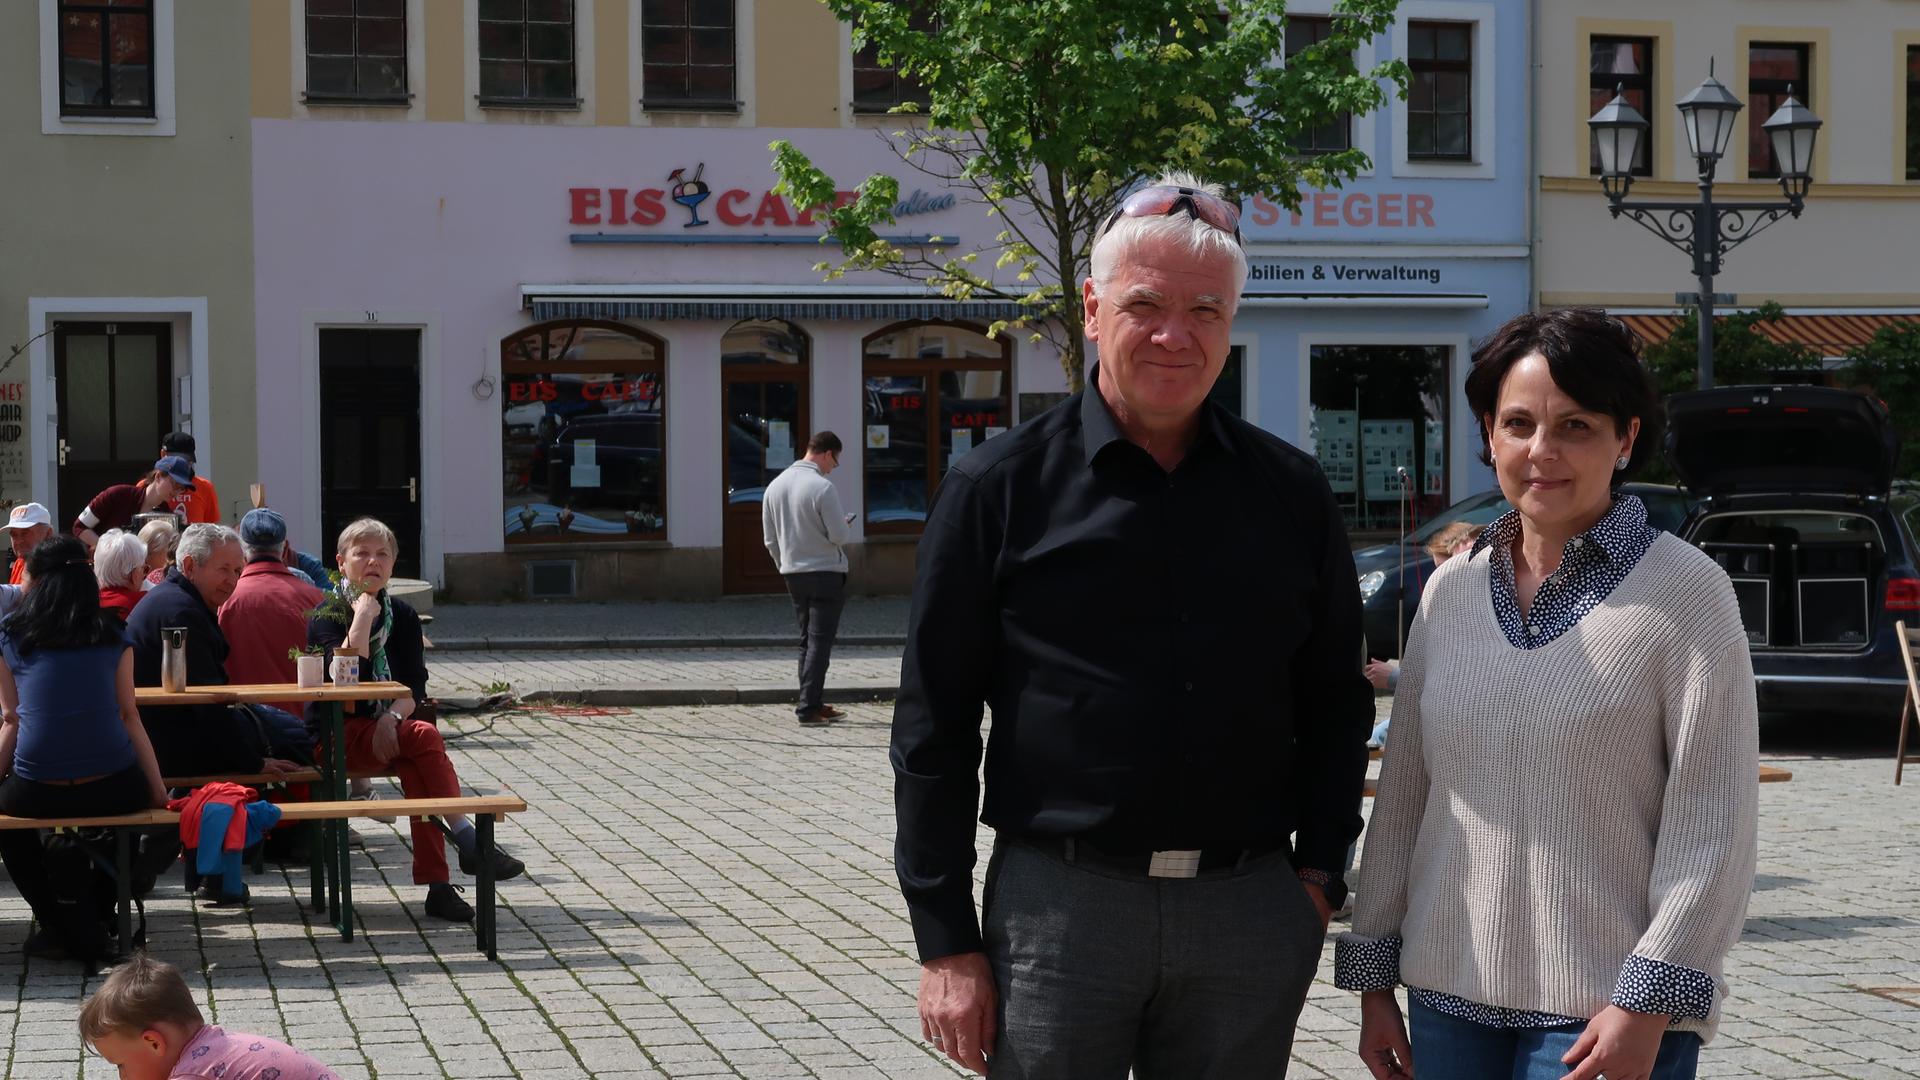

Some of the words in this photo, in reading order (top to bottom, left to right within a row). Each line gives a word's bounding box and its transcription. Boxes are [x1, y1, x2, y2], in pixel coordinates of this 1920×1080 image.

[569, 188, 666, 226] EIS
[1247, 265, 1304, 280] bilien
[1312, 265, 1325, 280] &
[1332, 265, 1441, 284] Verwaltung
[509, 382, 558, 401] EIS
[580, 382, 655, 401] CAFE
[890, 395, 922, 410] EIS
[950, 411, 998, 427] CAFE
